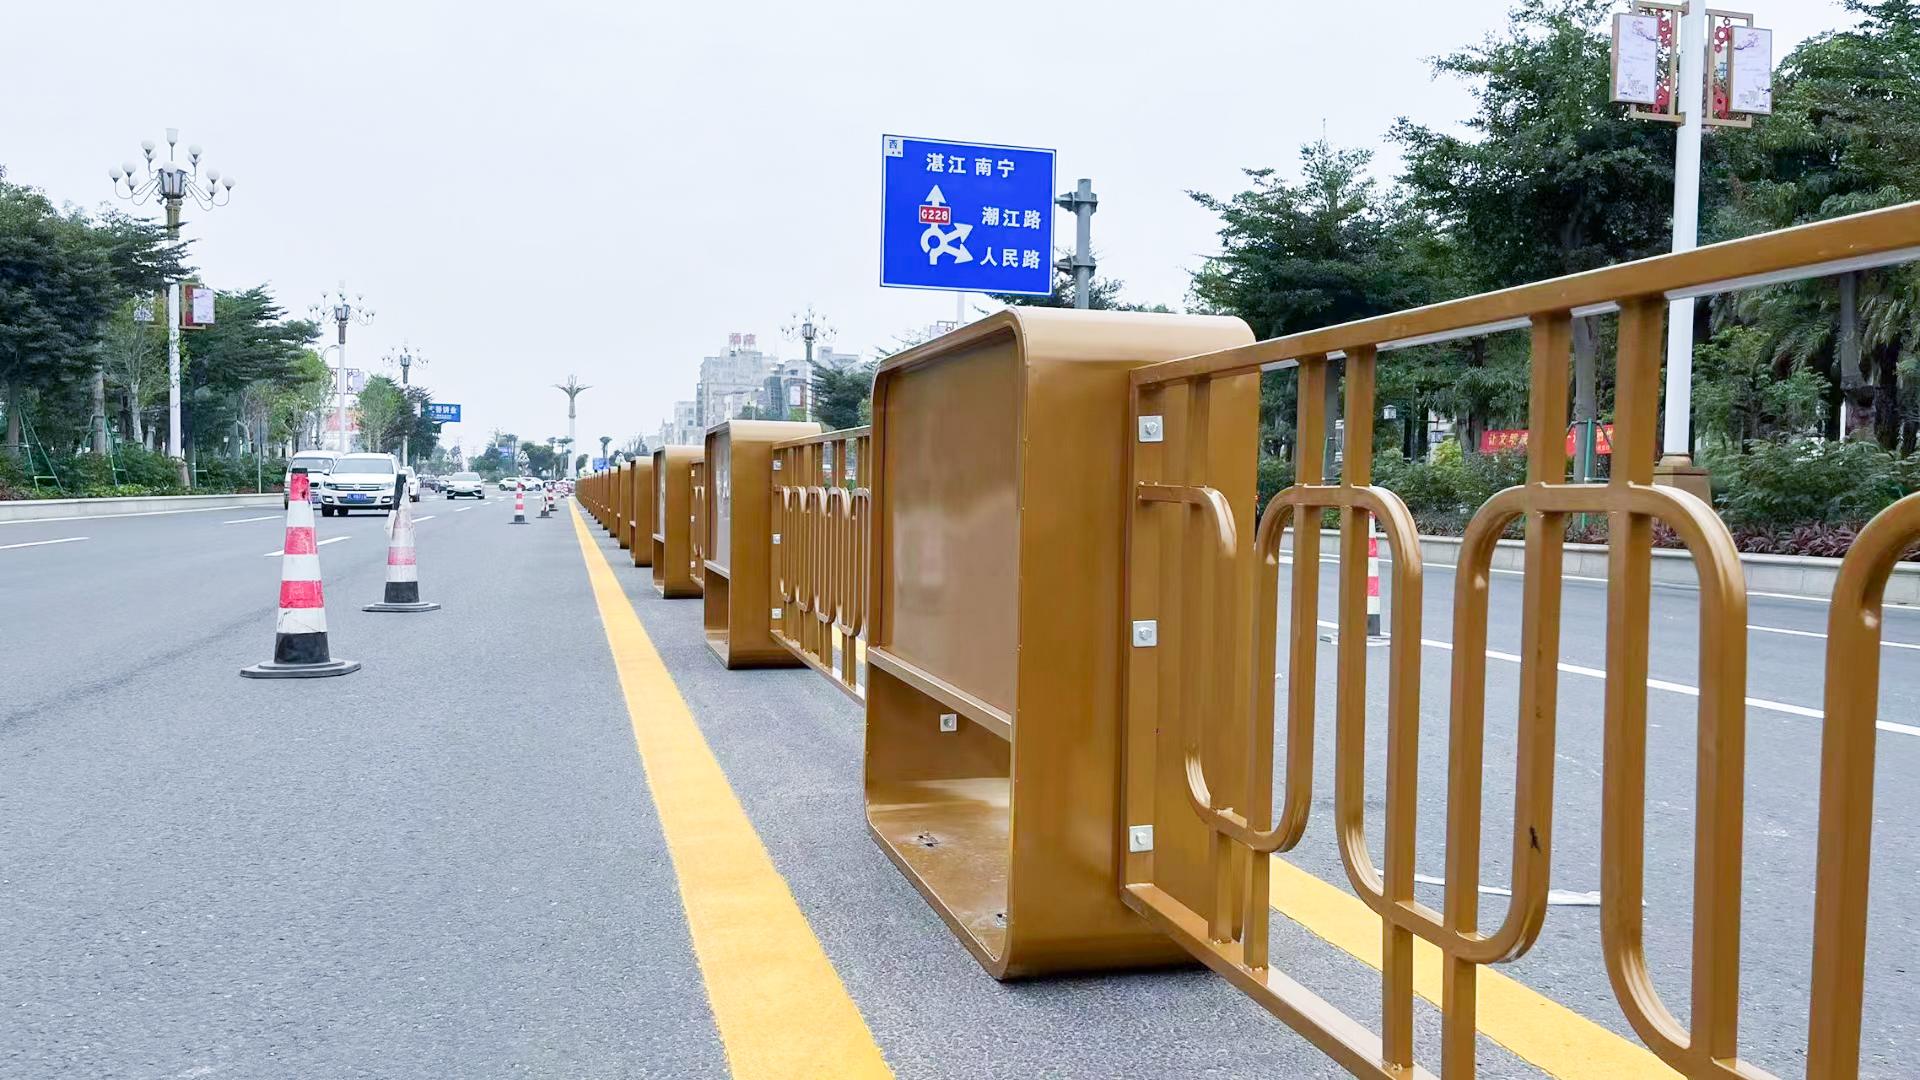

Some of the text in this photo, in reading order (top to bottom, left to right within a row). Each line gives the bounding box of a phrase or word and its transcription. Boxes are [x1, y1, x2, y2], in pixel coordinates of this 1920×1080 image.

[926, 152, 1015, 178] 湛江 南宁
[921, 209, 949, 221] G228
[981, 206, 1042, 229] 潮江路
[979, 246, 1041, 270] 人民路
